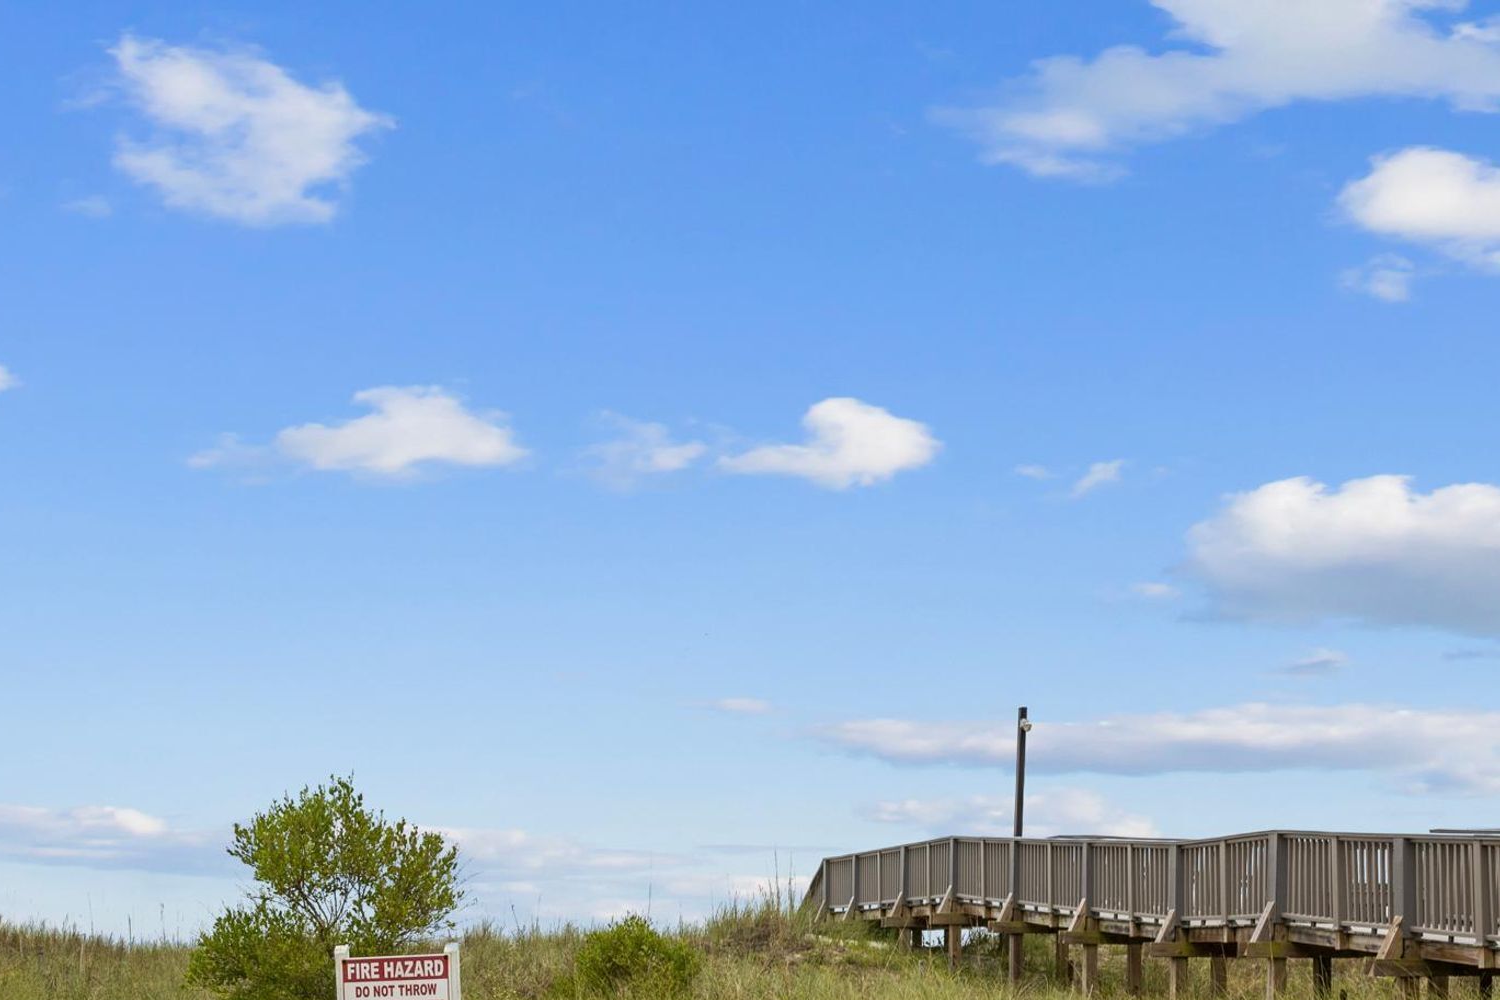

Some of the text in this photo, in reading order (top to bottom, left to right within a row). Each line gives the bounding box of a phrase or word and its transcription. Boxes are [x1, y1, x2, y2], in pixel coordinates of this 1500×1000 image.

[347, 960, 444, 979] FIRE HAZARD
[356, 984, 436, 998] DO NOT THROW
